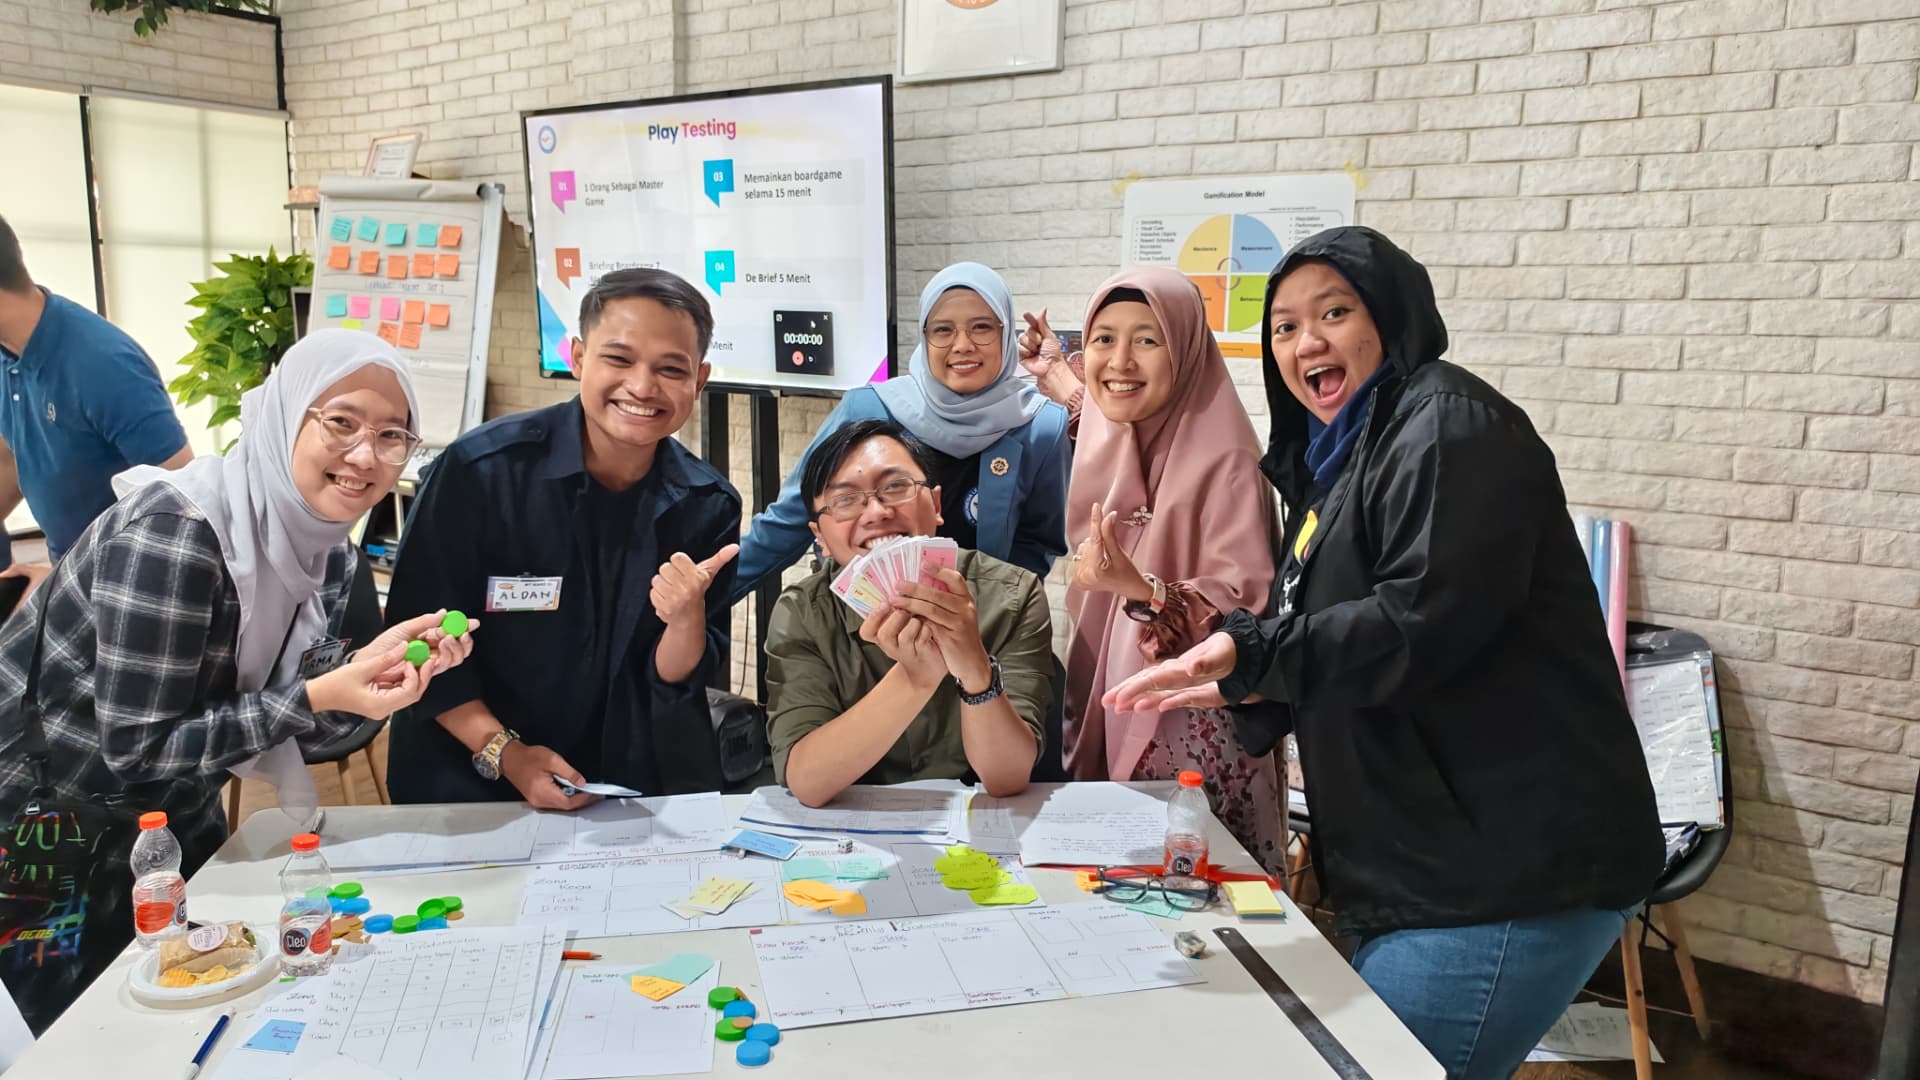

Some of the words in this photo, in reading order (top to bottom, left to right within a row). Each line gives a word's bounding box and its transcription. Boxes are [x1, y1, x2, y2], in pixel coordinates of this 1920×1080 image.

[648, 124, 679, 144] Play
[681, 118, 737, 140] Testing
[744, 172, 793, 184] Memainkan
[794, 169, 843, 182] boardgame
[590, 183, 610, 193] Orang
[611, 180, 638, 192] Sebagai
[639, 180, 664, 190] Master
[745, 190, 773, 199] selama
[775, 188, 785, 198] 15
[787, 187, 812, 198] menit
[585, 198, 605, 206] Game
[745, 273, 757, 283] De
[758, 273, 778, 283] Brief
[779, 274, 785, 283] 5
[786, 273, 811, 283] Menit
[783, 333, 823, 345] 00:00:00
[500, 590, 550, 600] ALDAN
[1176, 859, 1192, 873] Cleo
[286, 934, 306, 948] Cleo
